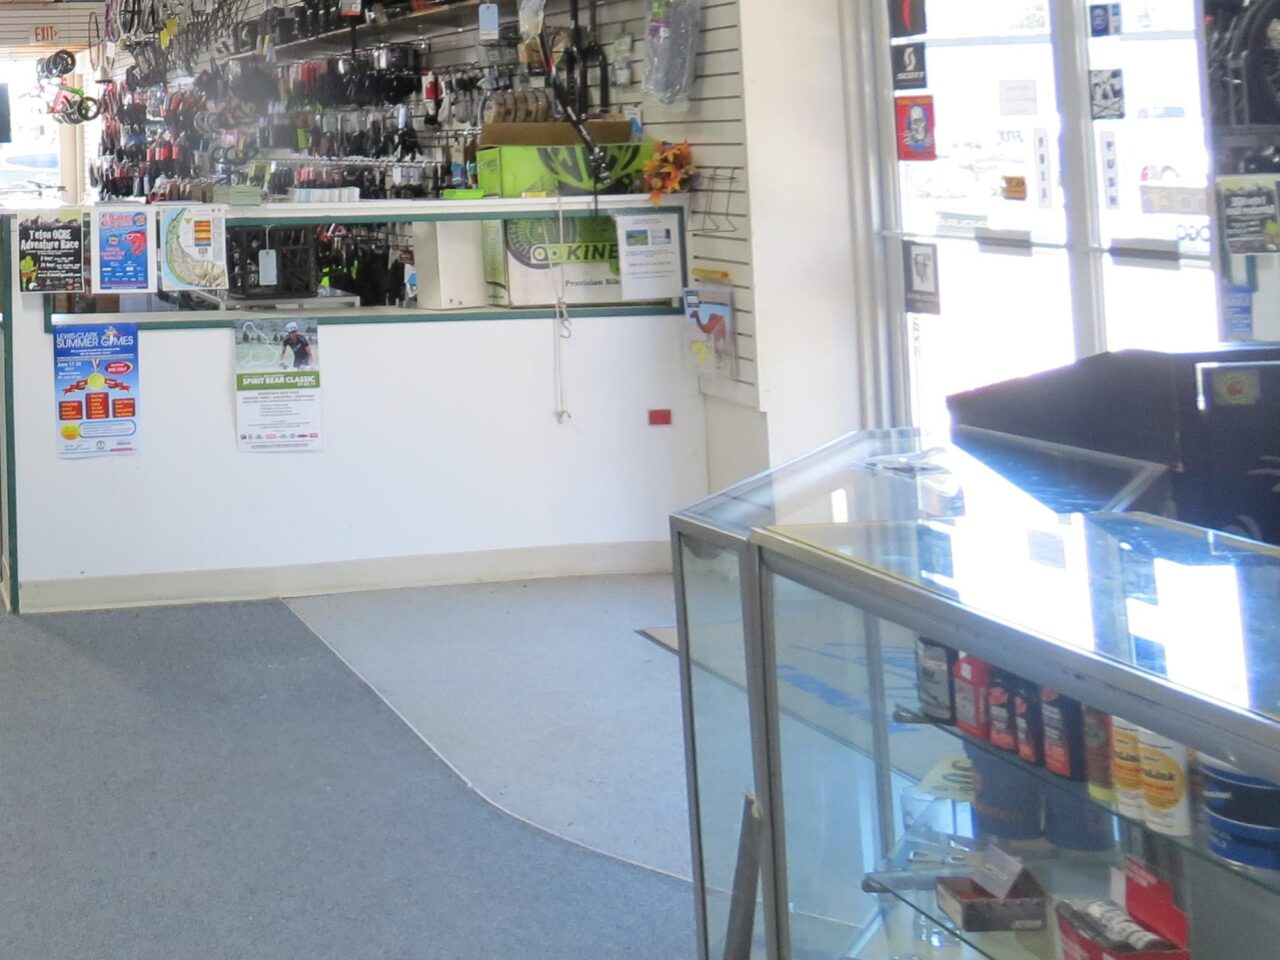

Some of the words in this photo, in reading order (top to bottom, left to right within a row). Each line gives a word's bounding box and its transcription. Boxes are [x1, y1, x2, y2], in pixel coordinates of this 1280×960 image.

[35, 26, 54, 41] EXIT
[896, 71, 924, 80] SCOTT
[21, 239, 59, 250] Adventure
[61, 241, 79, 249] Race
[56, 336, 98, 349] SUMMER
[242, 376, 263, 385] SPIRIT
[265, 375, 284, 384] BEAR
[286, 374, 315, 383] CLASSIC
